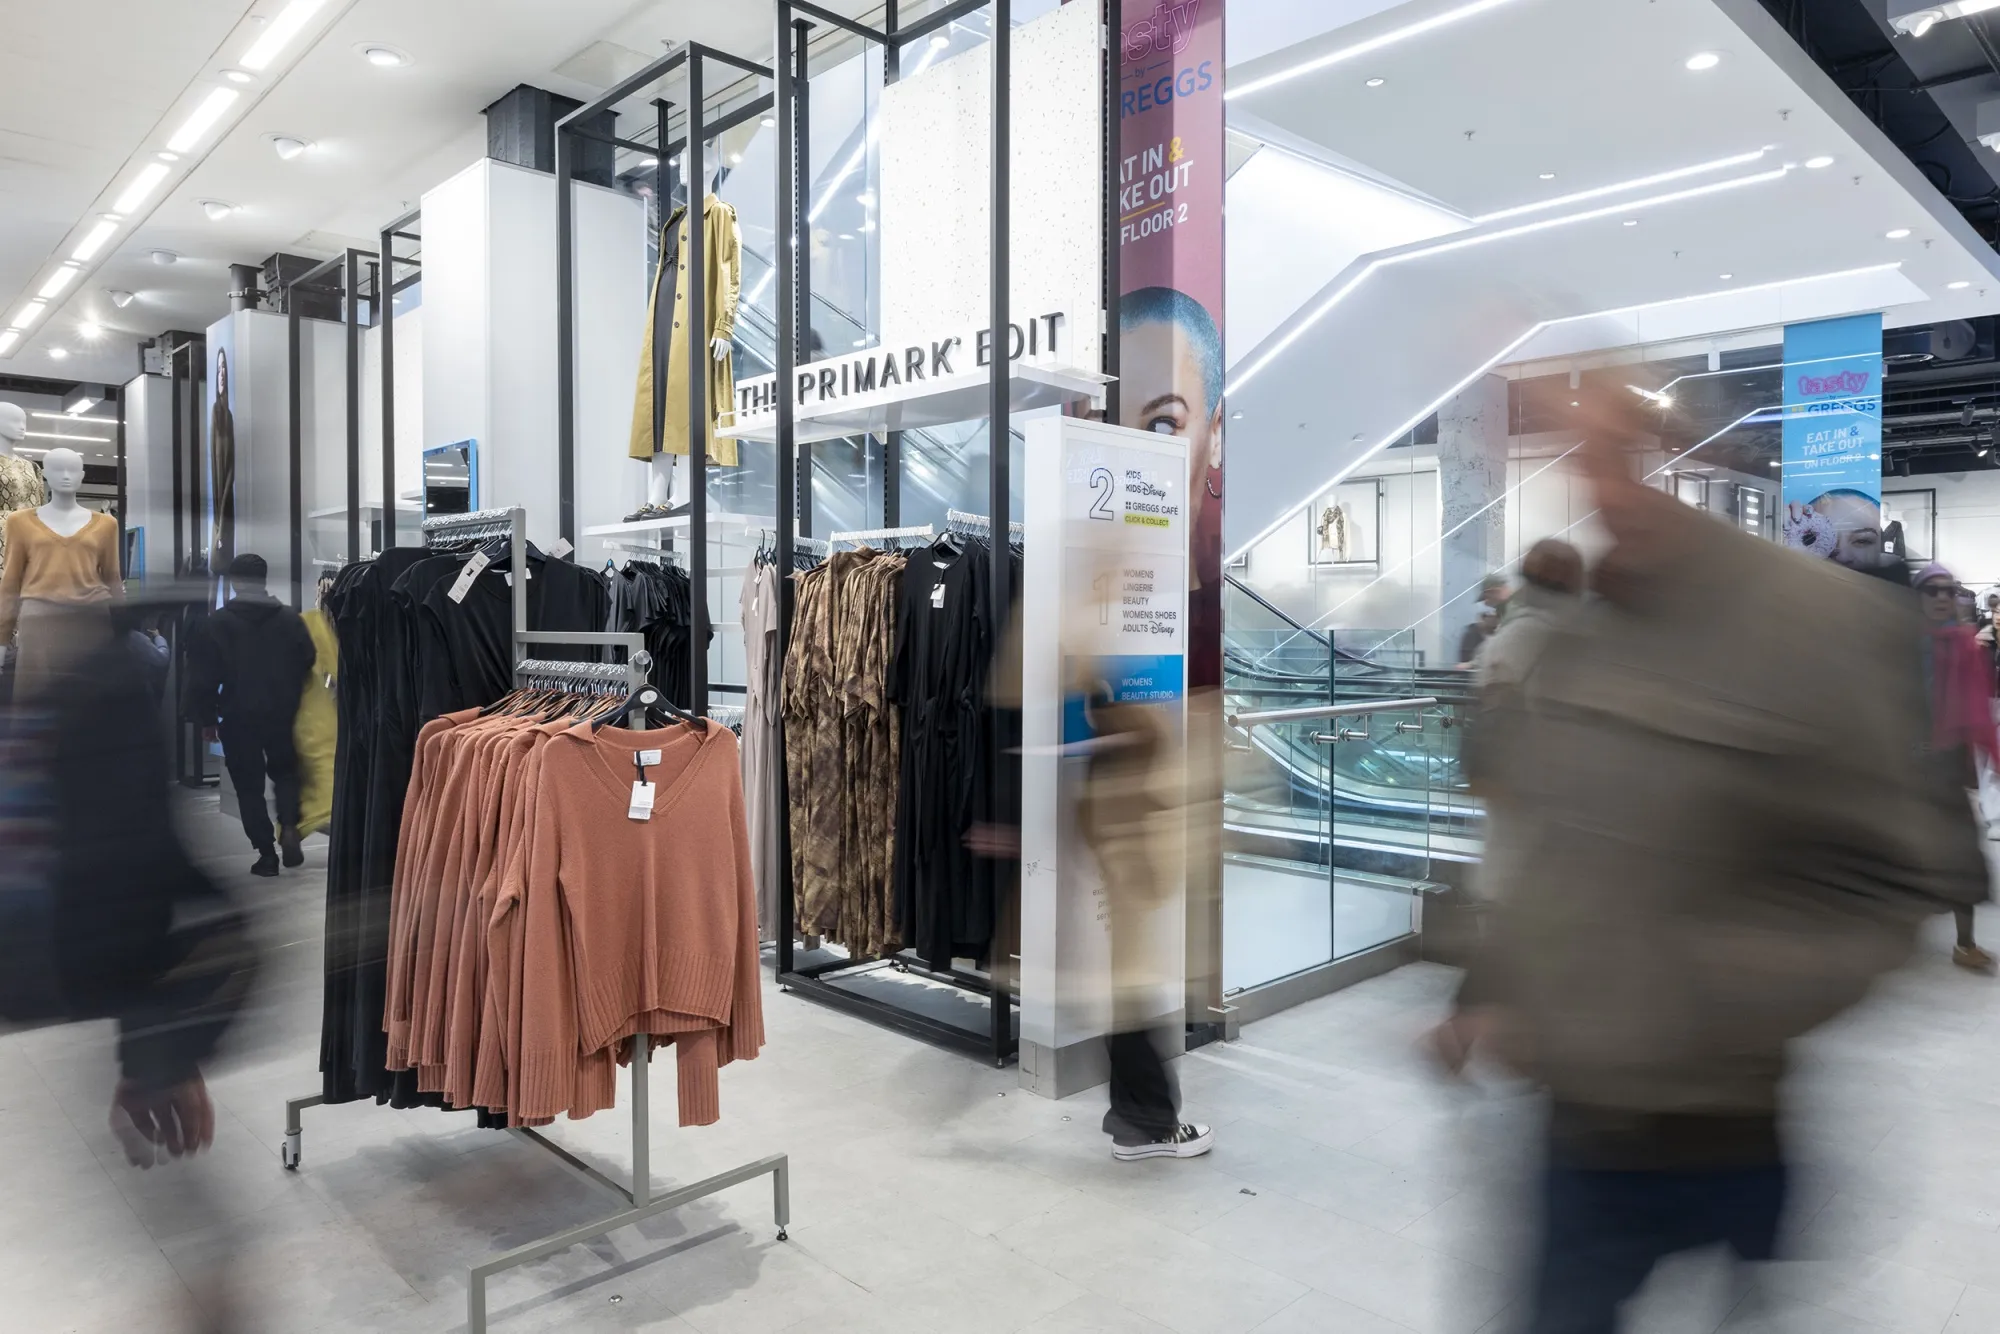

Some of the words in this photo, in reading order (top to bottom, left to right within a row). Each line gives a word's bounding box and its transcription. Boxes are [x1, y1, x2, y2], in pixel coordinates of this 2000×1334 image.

[1121, 0, 1199, 65] sty
[1134, 66, 1146, 79] by
[1121, 60, 1213, 119] REGGS
[1142, 143, 1163, 175] IN
[1168, 136, 1185, 163] &
[1119, 181, 1145, 214] KE
[1149, 159, 1194, 200] OUT
[1120, 208, 1174, 246] FLOOR
[1177, 202, 1188, 224] 2
[976, 311, 1064, 367] EDIT
[1798, 371, 1869, 396] tasty
[1807, 431, 1831, 444] EAT
[1833, 427, 1848, 439] IN
[1850, 425, 1860, 437] &
[1802, 441, 1836, 456] TAKE
[1838, 436, 1865, 451] OUT
[1125, 470, 1142, 480] KIDS
[1089, 467, 1114, 521] 2
[1125, 484, 1142, 493] KIDS
[1139, 481, 1166, 501] Disney
[1132, 502, 1160, 514] GREGGS
[1161, 506, 1179, 516] CAFÉ
[1124, 516, 1141, 524] CLICK
[1146, 517, 1169, 527] COLLECT
[1123, 568, 1154, 579] WOMENS
[1122, 583, 1154, 592] LINGERIE
[1122, 597, 1150, 605] BEAUTY
[1122, 610, 1154, 619] WOMENS
[1154, 611, 1177, 620] SHOES
[1122, 624, 1149, 633] ADULTS
[1148, 621, 1175, 638] Disney
[1121, 678, 1153, 687] WOMENS
[1121, 692, 1148, 701] BEAUTY
[1149, 690, 1174, 699] STUDIO
